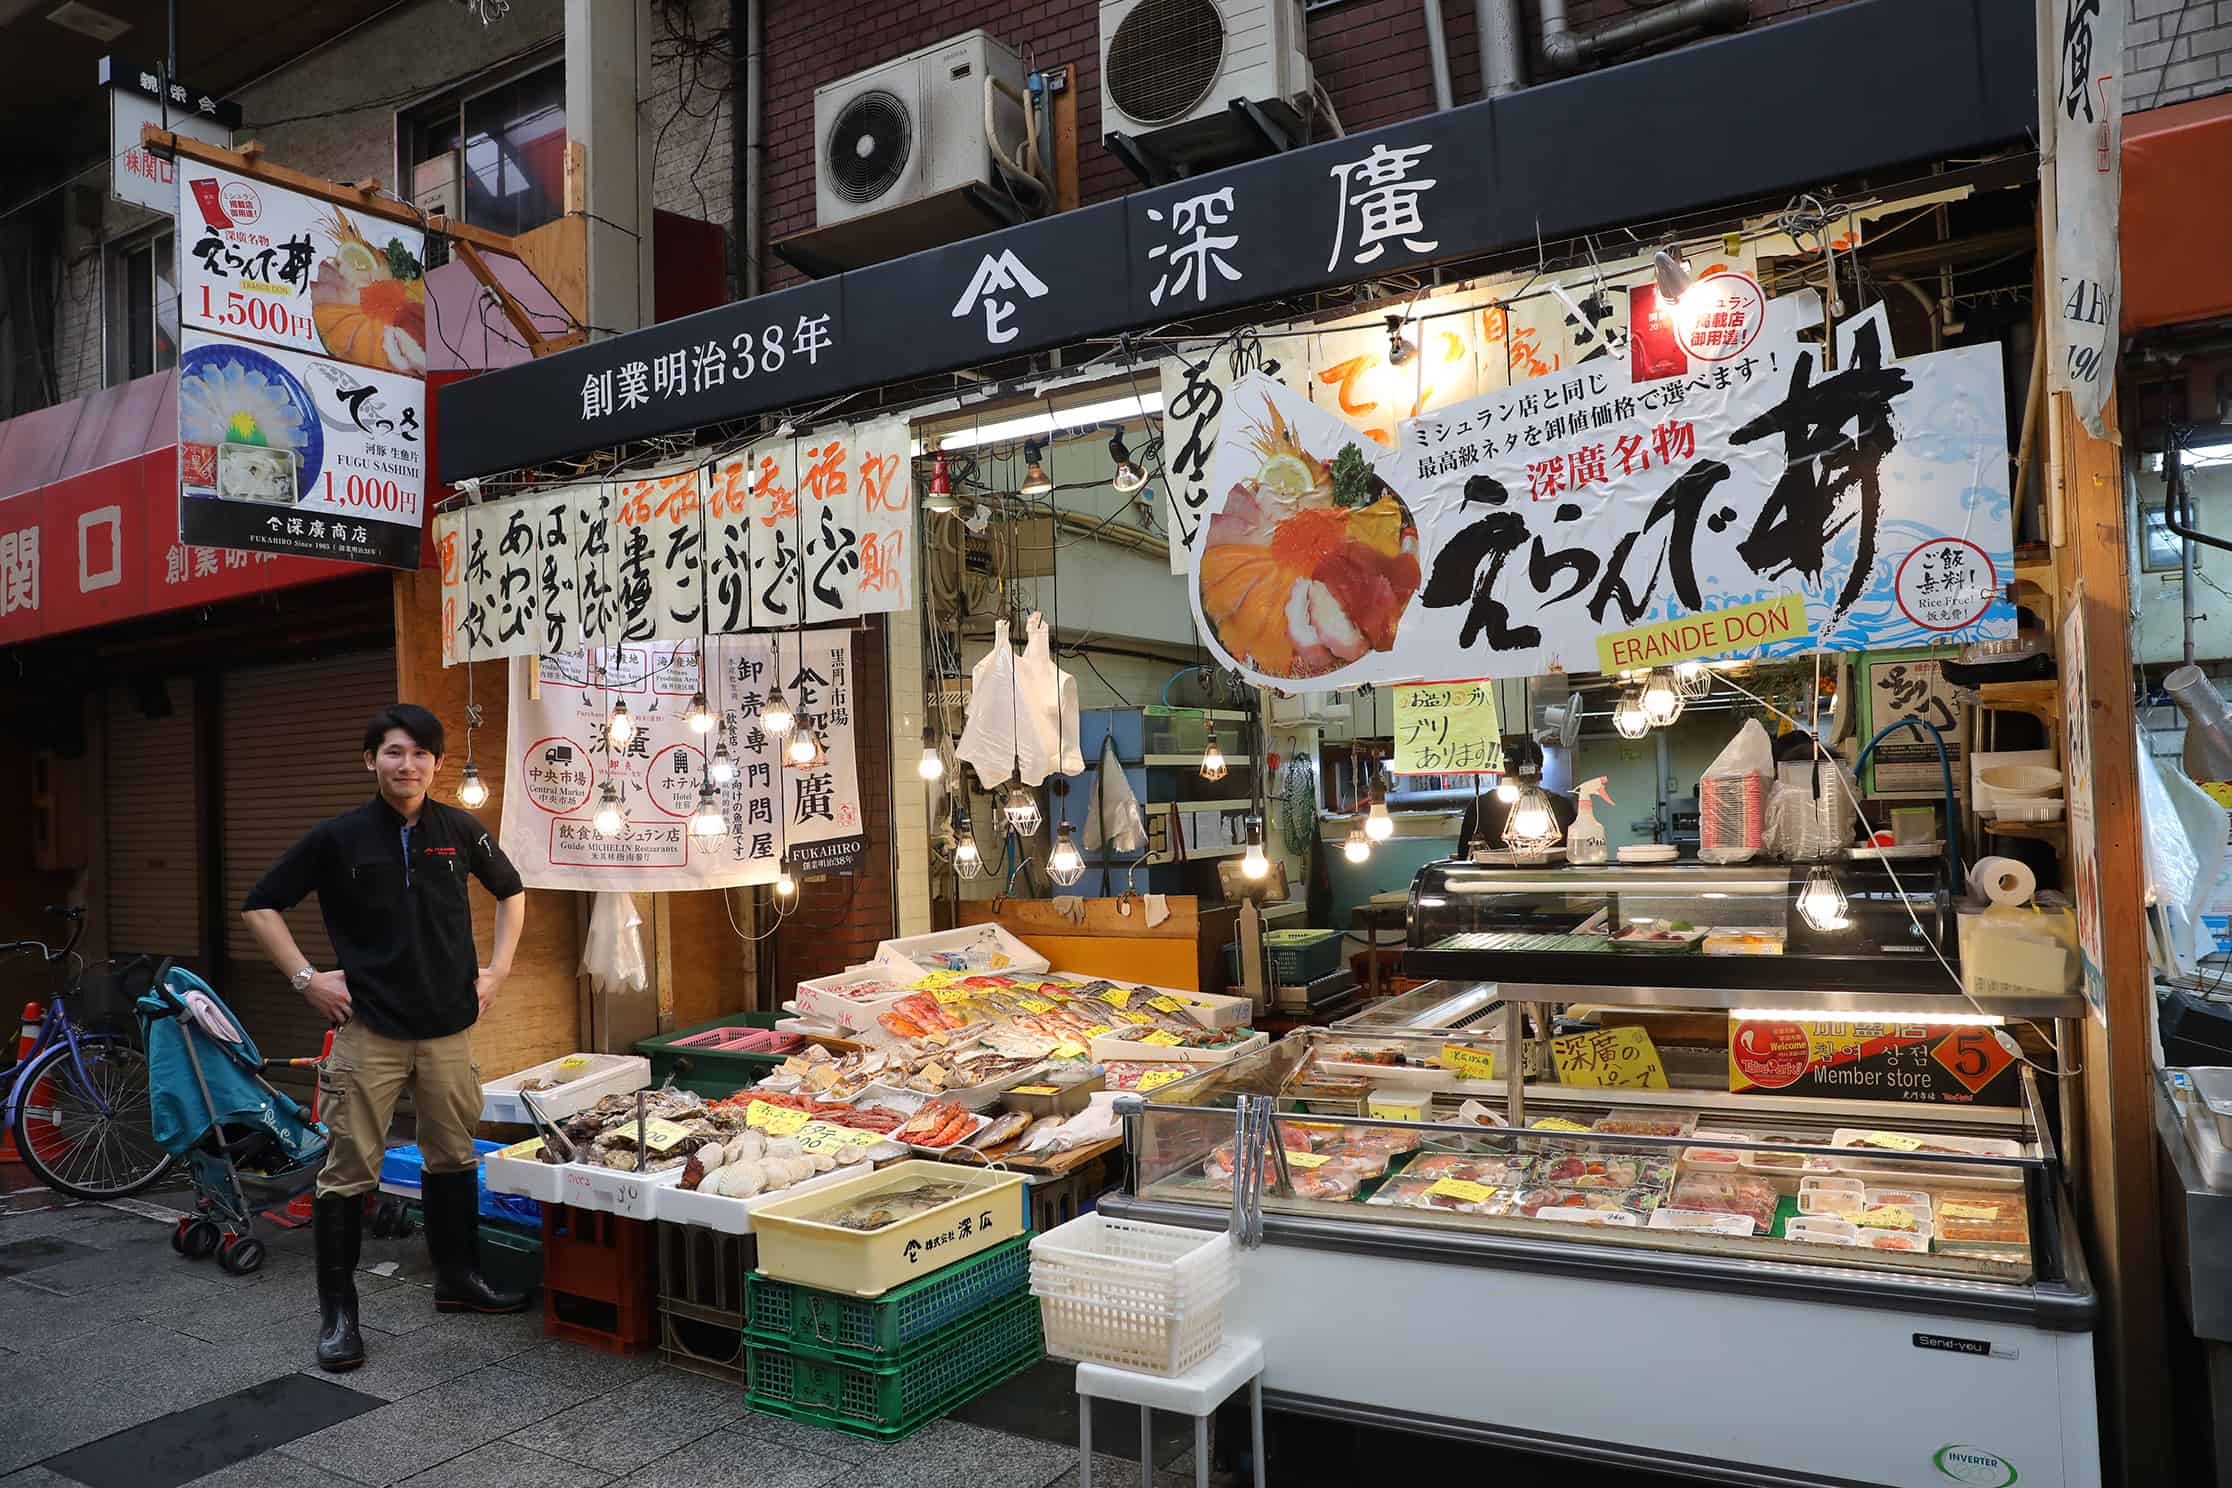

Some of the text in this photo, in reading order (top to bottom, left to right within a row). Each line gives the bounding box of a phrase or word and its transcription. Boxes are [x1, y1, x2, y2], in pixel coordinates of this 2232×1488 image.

[1147, 142, 1440, 307] 深廣
[199, 284, 314, 342] 1,500円
[580, 313, 835, 421] 創業明治38年
[335, 384, 419, 442] てっさ
[1414, 372, 1608, 447] ミシュラン店と同じ
[336, 454, 420, 479] FUGU SASHIMI
[1526, 418, 1697, 502] 深廣名物
[323, 471, 417, 515] 1,000円
[1420, 317, 1913, 650] えらんで丼
[249, 534, 293, 546] FUKAHIRO
[1922, 546, 1965, 570] ご飯
[1916, 569, 1976, 595] 無料!
[1919, 598, 1942, 609] Rice
[1612, 607, 1792, 667] ERANDE DON
[829, 648, 850, 726] 黒門市場
[1399, 715, 1449, 746] ブリ
[737, 656, 776, 860] 卸売専門問屋
[529, 767, 588, 787] 中央市場
[529, 784, 586, 798] Central Market
[673, 792, 693, 802] Hotel
[560, 841, 586, 851] Guide
[793, 840, 861, 863] FUKAHIRO
[1956, 1031, 1991, 1078] 5
[1813, 1065, 1882, 1087] Member
[1887, 1067, 1932, 1089] store
[1919, 1336, 1983, 1352] Send-you
[1949, 1452, 1998, 1468] INVERTER
